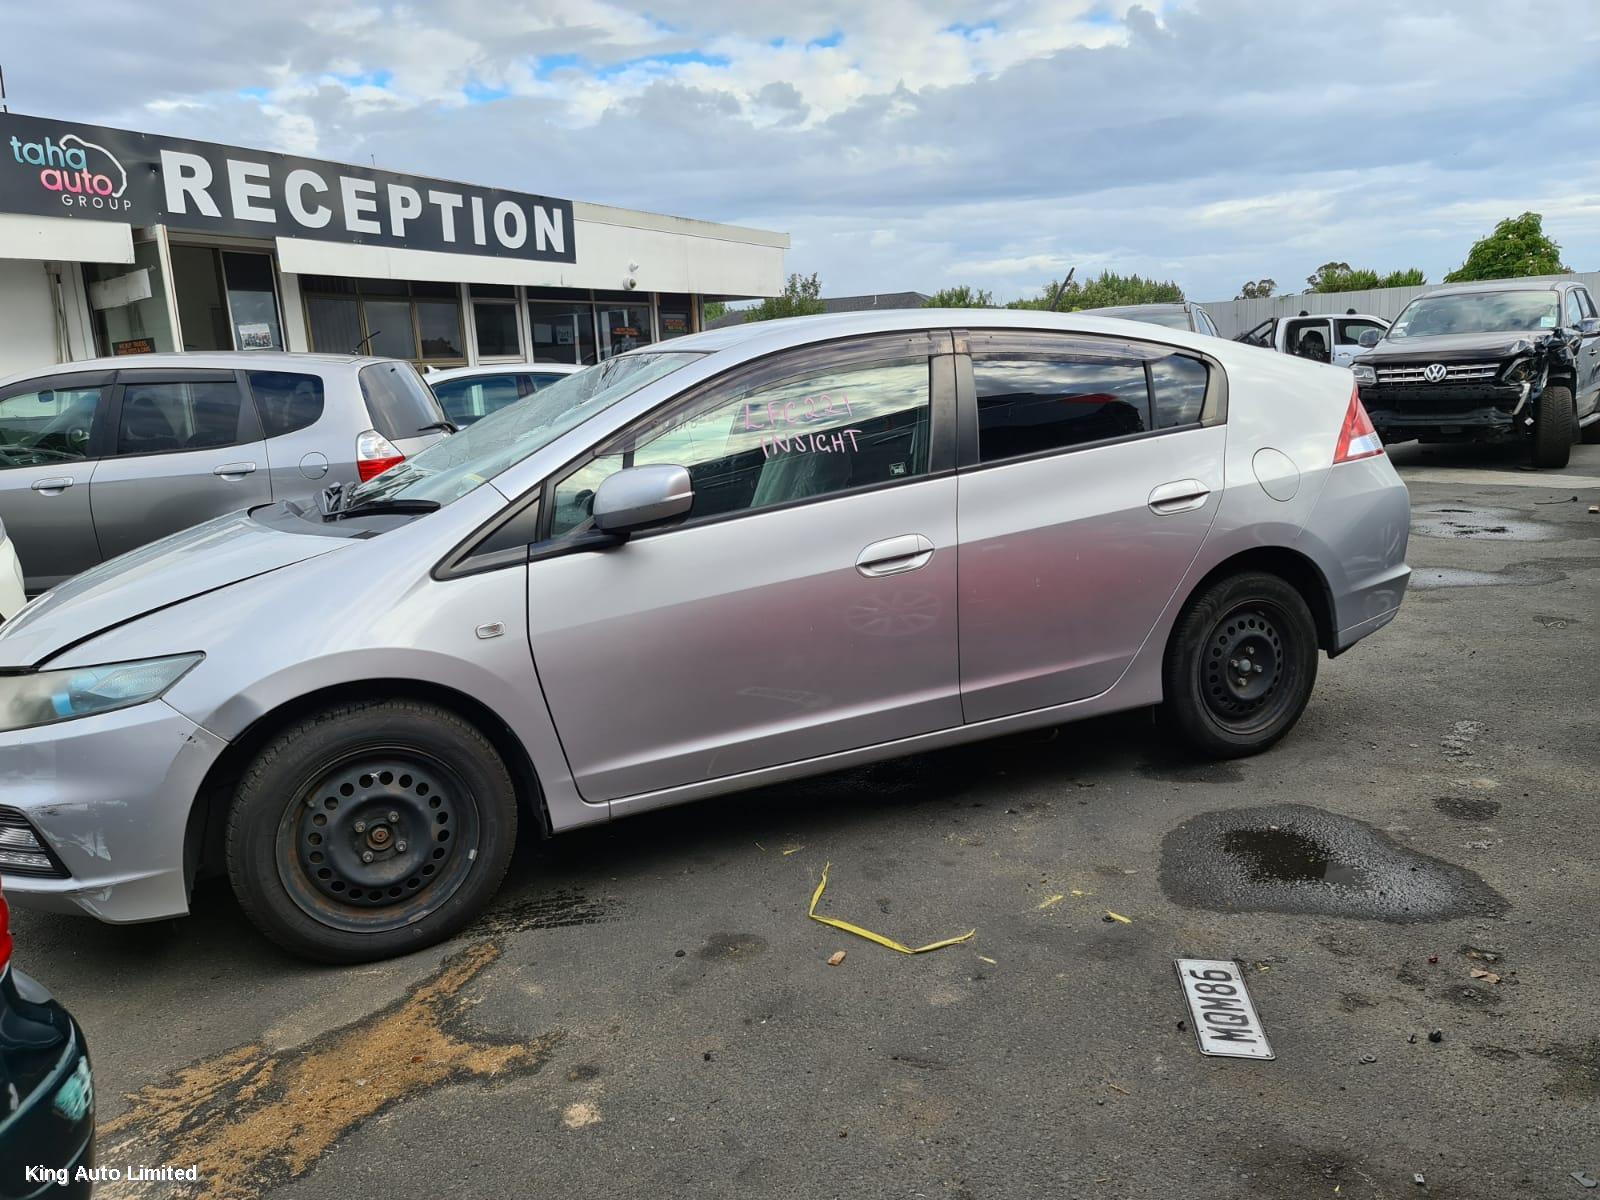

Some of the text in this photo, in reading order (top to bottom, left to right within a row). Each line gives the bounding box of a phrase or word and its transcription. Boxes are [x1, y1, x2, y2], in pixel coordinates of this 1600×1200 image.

[10, 136, 87, 169] taha
[41, 168, 112, 196] auto
[62, 194, 131, 211] GROUP
[160, 149, 565, 253] RECEPTION
[760, 429, 862, 458] INSIGHT
[1189, 969, 1257, 1043] MQM86
